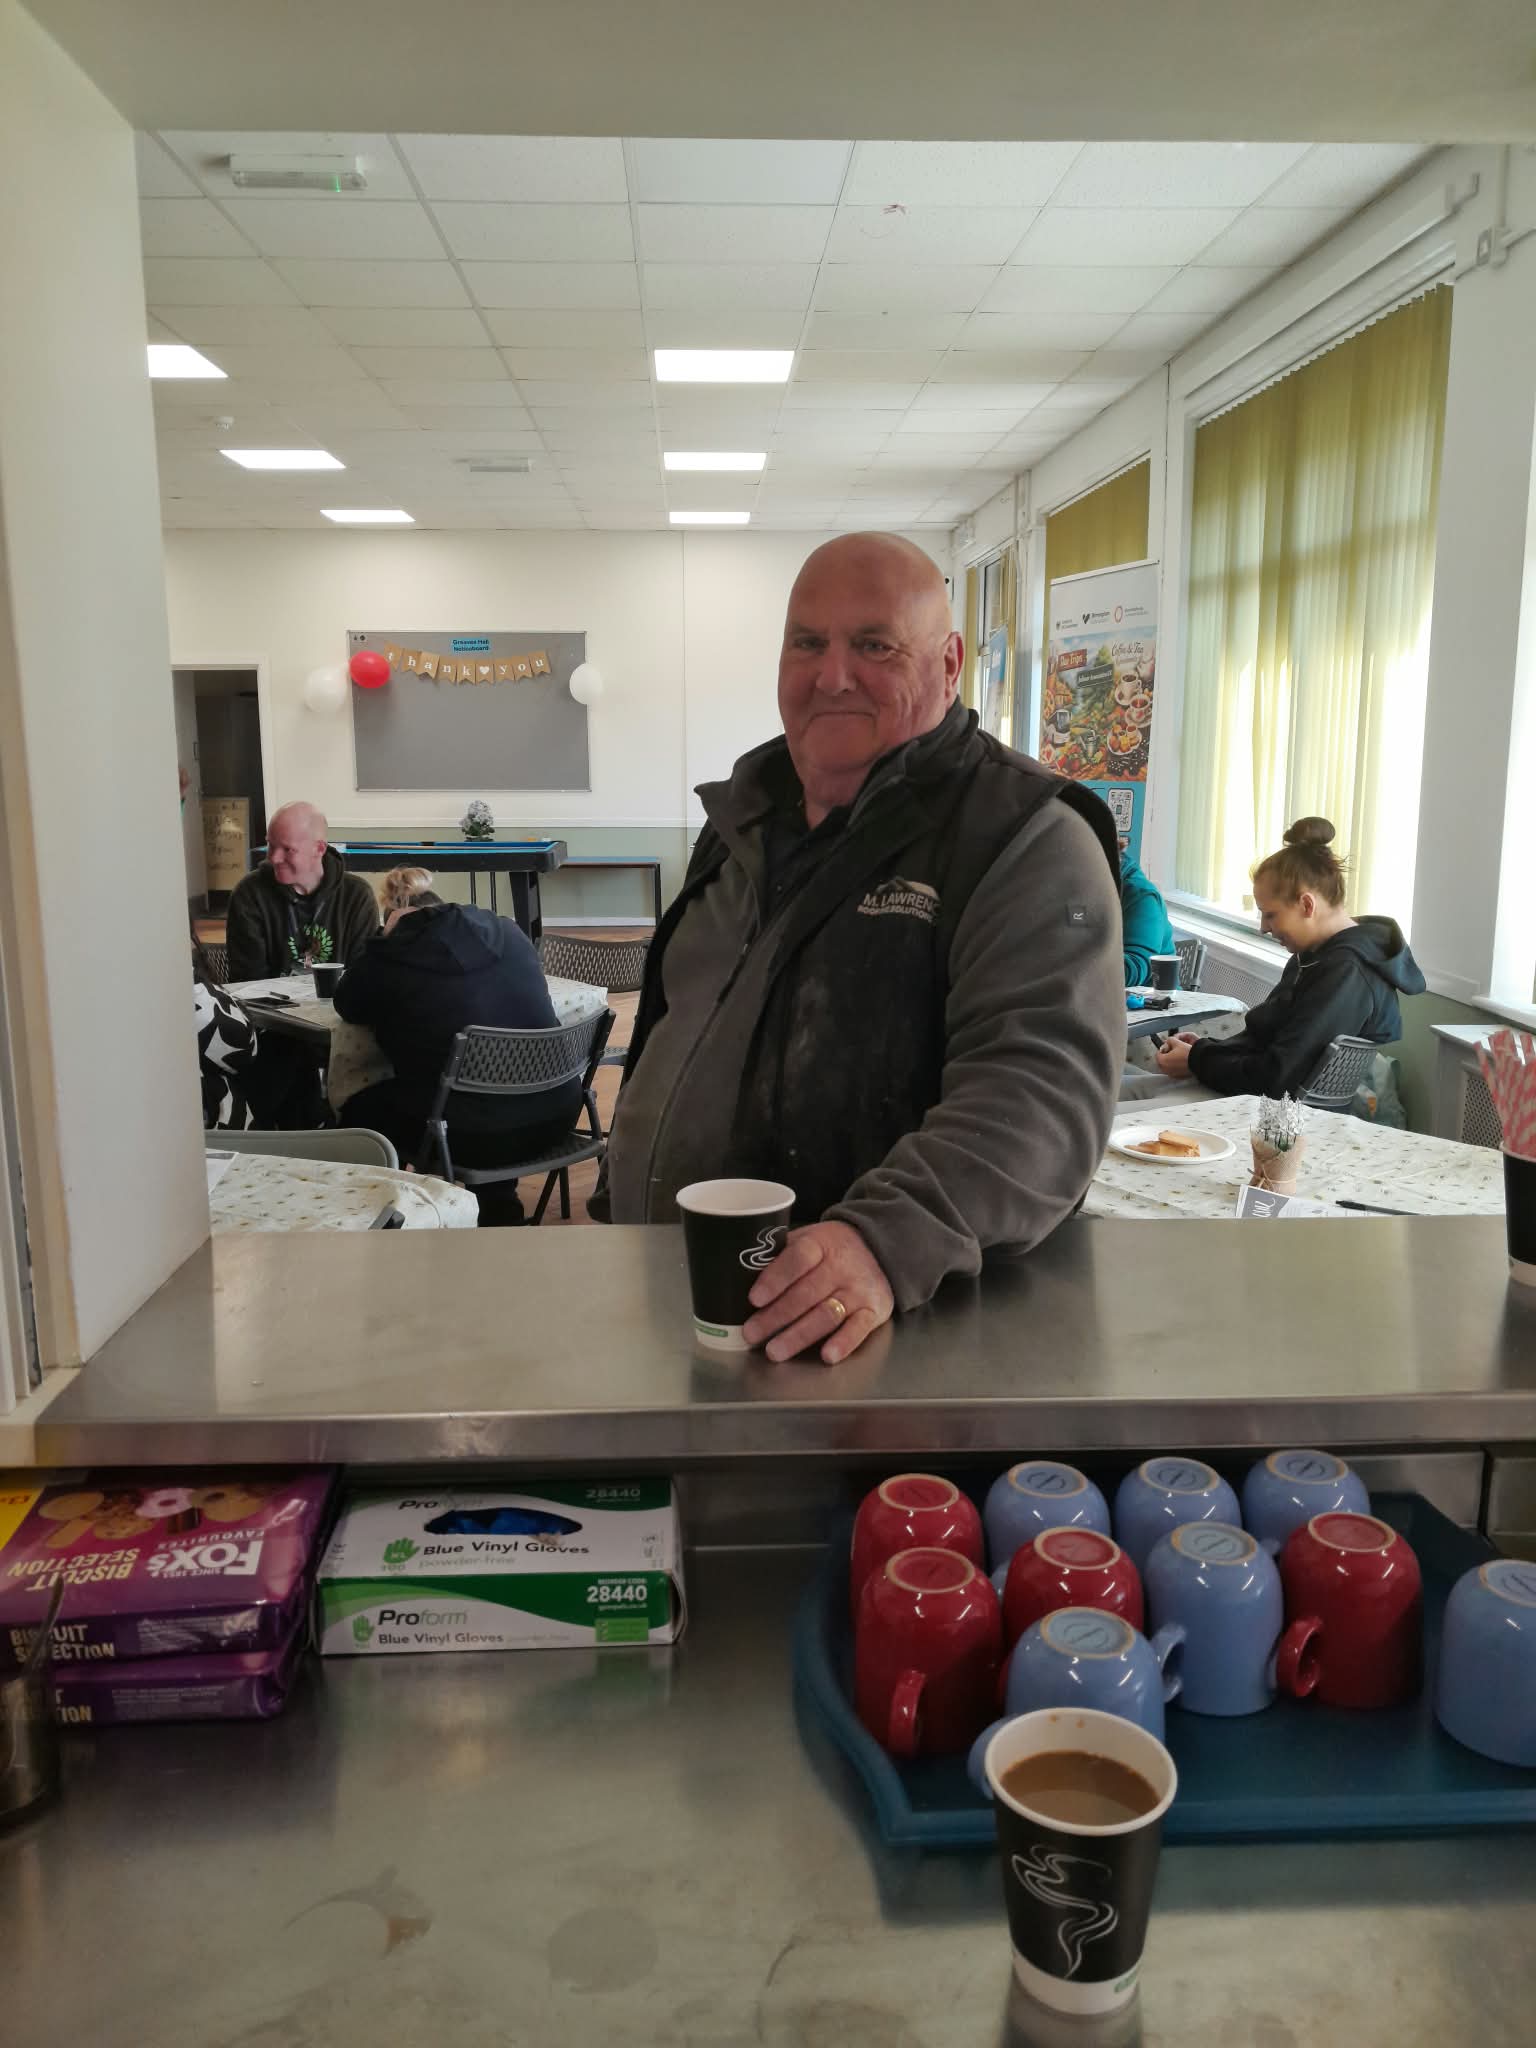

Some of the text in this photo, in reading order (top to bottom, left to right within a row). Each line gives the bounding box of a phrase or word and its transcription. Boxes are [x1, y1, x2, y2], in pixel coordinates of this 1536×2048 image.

[388, 652, 545, 676] thank you
[422, 1541, 590, 1556] Blue Vinyl Gloves
[7, 1547, 141, 1578] SELECTION
[25, 1562, 135, 1593] BISCUIT
[586, 1584, 648, 1603] 28440
[377, 1609, 468, 1626] Proform
[8, 1624, 89, 1646] BISUIT
[378, 1633, 410, 1645] Blue
[413, 1632, 450, 1645] Vinyl
[454, 1632, 504, 1644] Gloves
[15, 1641, 115, 1664] SEECTION
